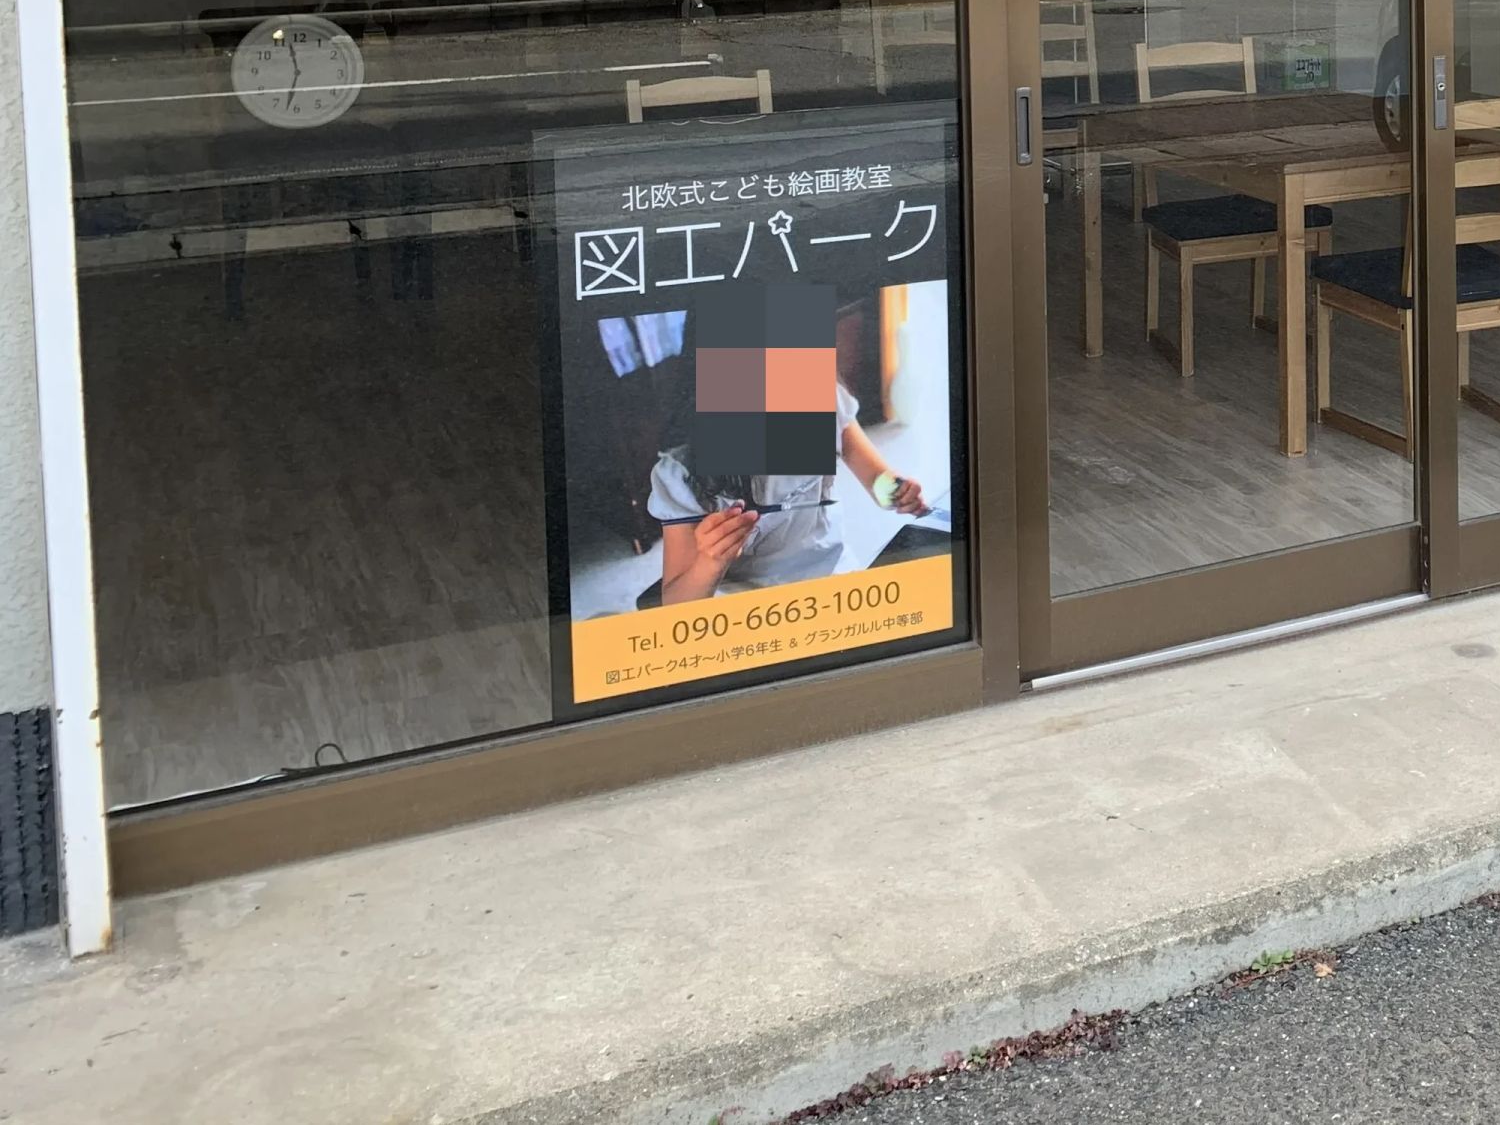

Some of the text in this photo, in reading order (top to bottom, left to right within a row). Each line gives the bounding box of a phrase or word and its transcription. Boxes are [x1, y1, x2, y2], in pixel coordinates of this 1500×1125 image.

[293, 33, 307, 43] 12
[317, 38, 322, 48] 1
[257, 50, 271, 60] 10
[330, 50, 338, 60] 2
[272, 98, 280, 108] 7
[314, 99, 322, 109] 5
[293, 104, 301, 114] 6
[621, 164, 893, 212] 北欧式こども絵画教室
[574, 200, 937, 301] 図工パーク
[628, 581, 900, 653] Tel. 090-6663-1000
[789, 637, 799, 649] &
[804, 611, 924, 646] グランガルル中等部
